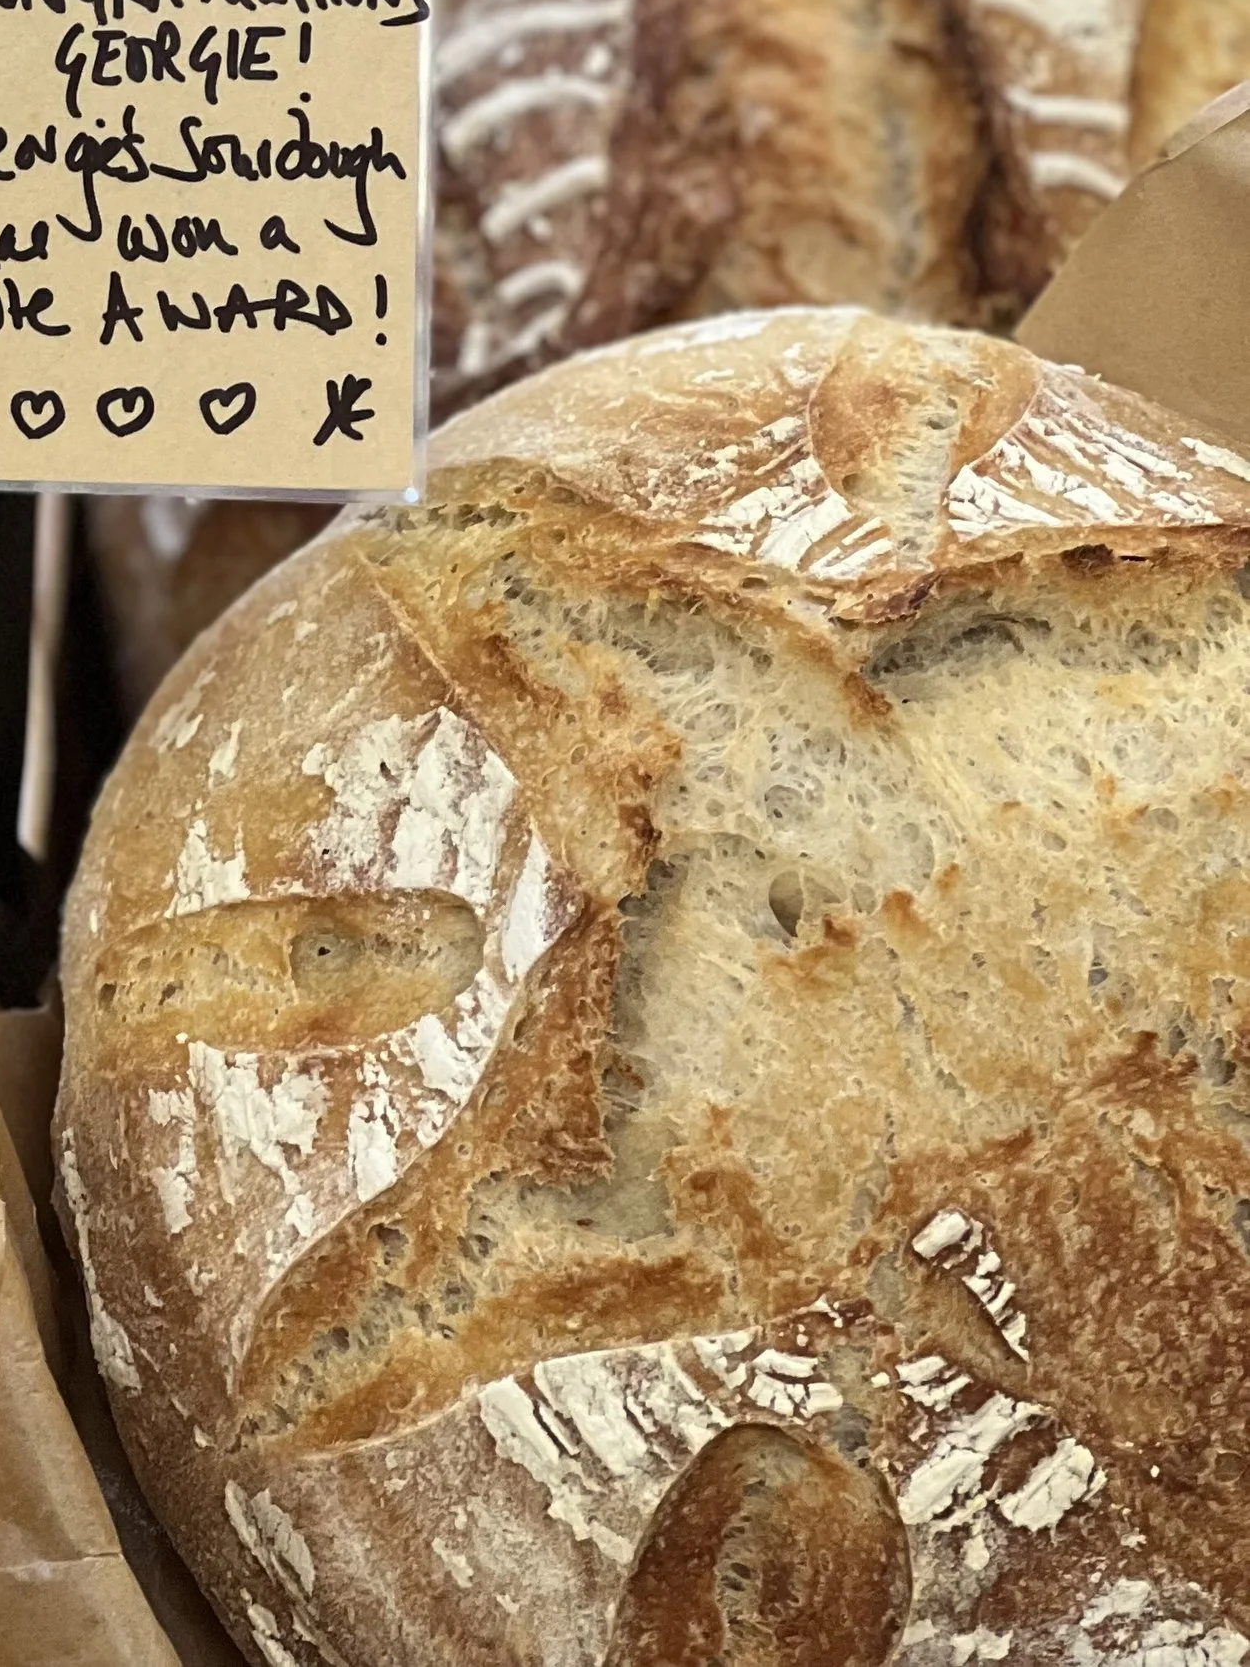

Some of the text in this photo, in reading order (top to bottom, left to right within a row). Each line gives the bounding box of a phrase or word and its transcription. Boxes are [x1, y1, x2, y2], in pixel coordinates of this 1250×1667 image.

[56, 23, 312, 117] GEORGIE!
[120, 214, 238, 262] won
[260, 216, 299, 253] a
